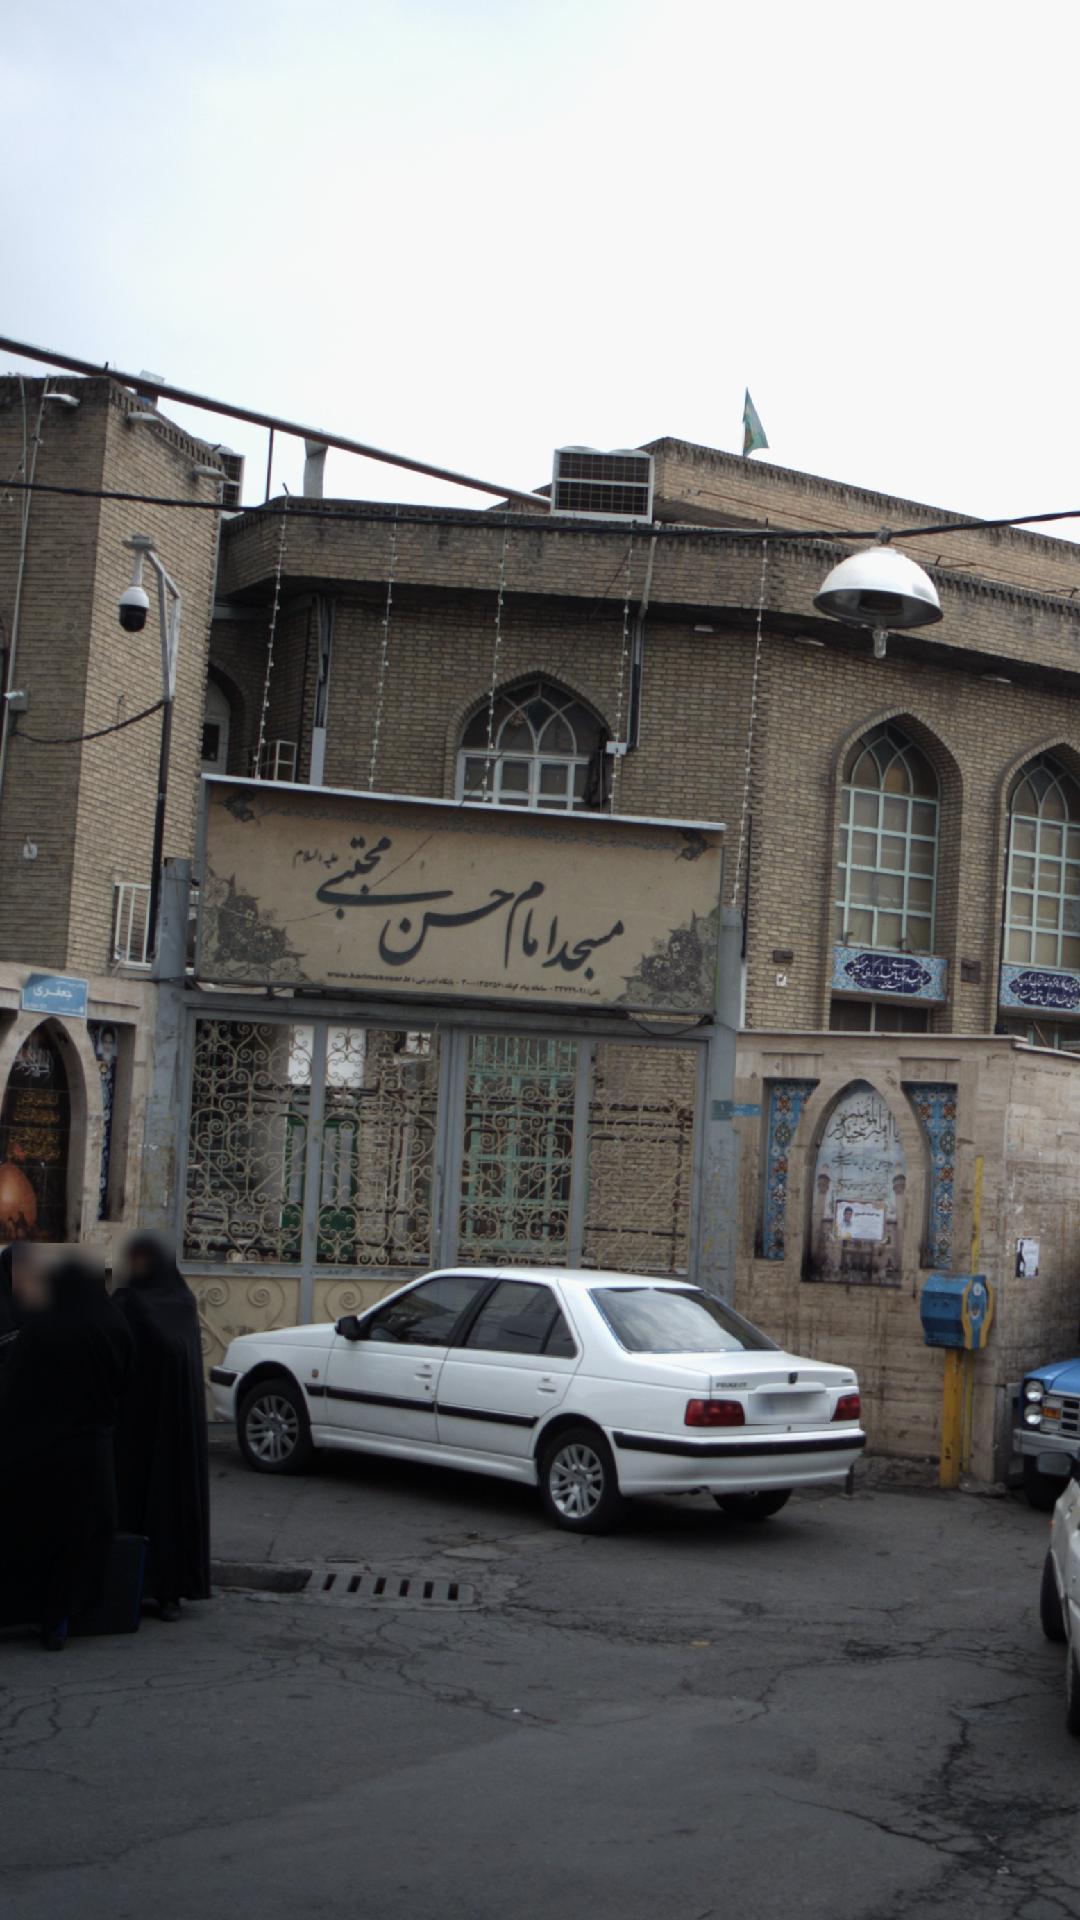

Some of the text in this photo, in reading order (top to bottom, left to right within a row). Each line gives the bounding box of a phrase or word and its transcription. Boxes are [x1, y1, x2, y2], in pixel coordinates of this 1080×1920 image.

[291, 848, 322, 870] السلام
[315, 836, 455, 920] مجتبی
[378, 887, 515, 967] حسن
[504, 880, 558, 969] امام
[543, 919, 625, 980] مسجد
[33, 985, 73, 1001] جعفری
